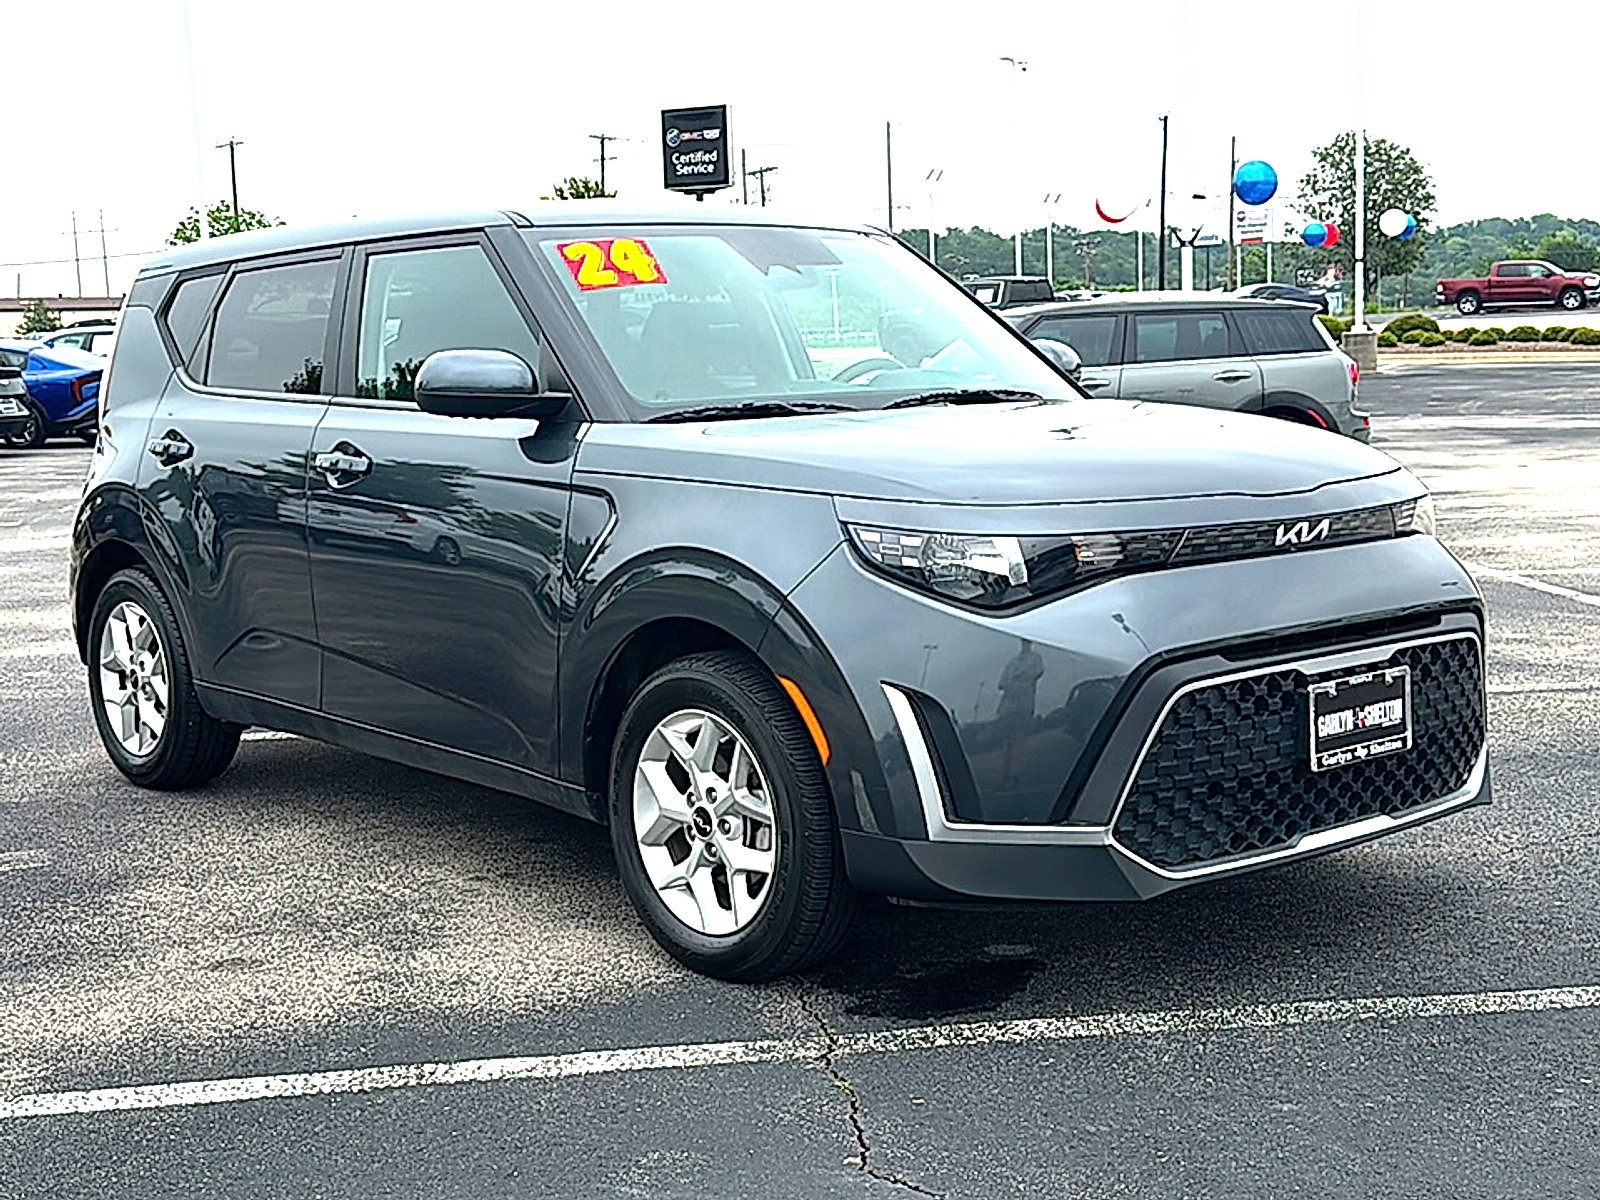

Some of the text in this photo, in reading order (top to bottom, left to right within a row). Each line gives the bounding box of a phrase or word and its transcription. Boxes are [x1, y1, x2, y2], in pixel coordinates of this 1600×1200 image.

[672, 150, 717, 164] Certified
[676, 163, 714, 175] Service
[563, 239, 659, 286] 24
[1275, 519, 1330, 546] KIA
